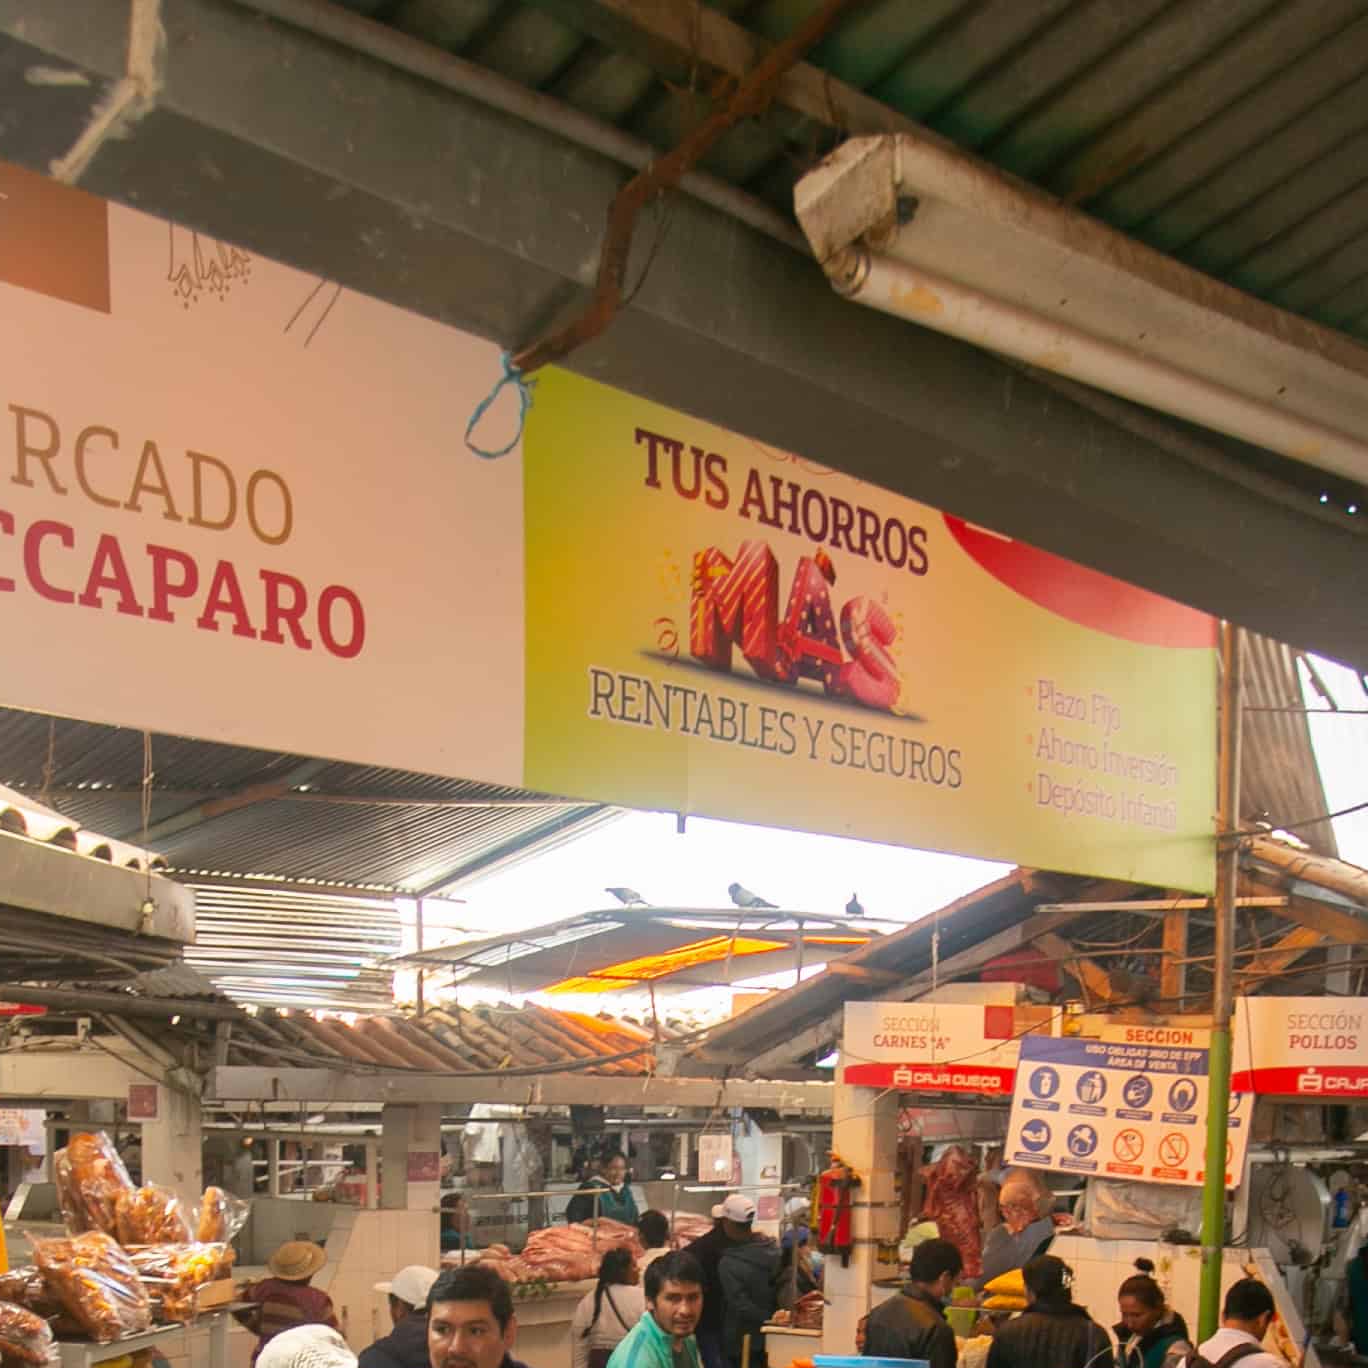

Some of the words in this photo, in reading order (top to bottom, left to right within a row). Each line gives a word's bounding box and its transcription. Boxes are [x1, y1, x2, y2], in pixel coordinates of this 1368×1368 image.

[635, 428, 730, 512] TUS
[739, 467, 929, 576] AHORROS
[1036, 679, 1087, 721] Plazo
[1091, 693, 1121, 737] Fijo
[589, 669, 797, 755] RENTABLES
[802, 713, 823, 758] Y
[830, 721, 962, 789] SEGUROS
[1036, 727, 1098, 771] Ahorro
[1036, 771, 1116, 819] Depósito
[882, 1015, 941, 1034] SECCIÓN
[1287, 1009, 1363, 1031] SECCIÓN
[873, 1034, 928, 1050] CARNES
[1125, 1028, 1194, 1045] SECCION
[1289, 1035, 1358, 1050] POLLOS
[913, 1072, 952, 1085] CAJA
